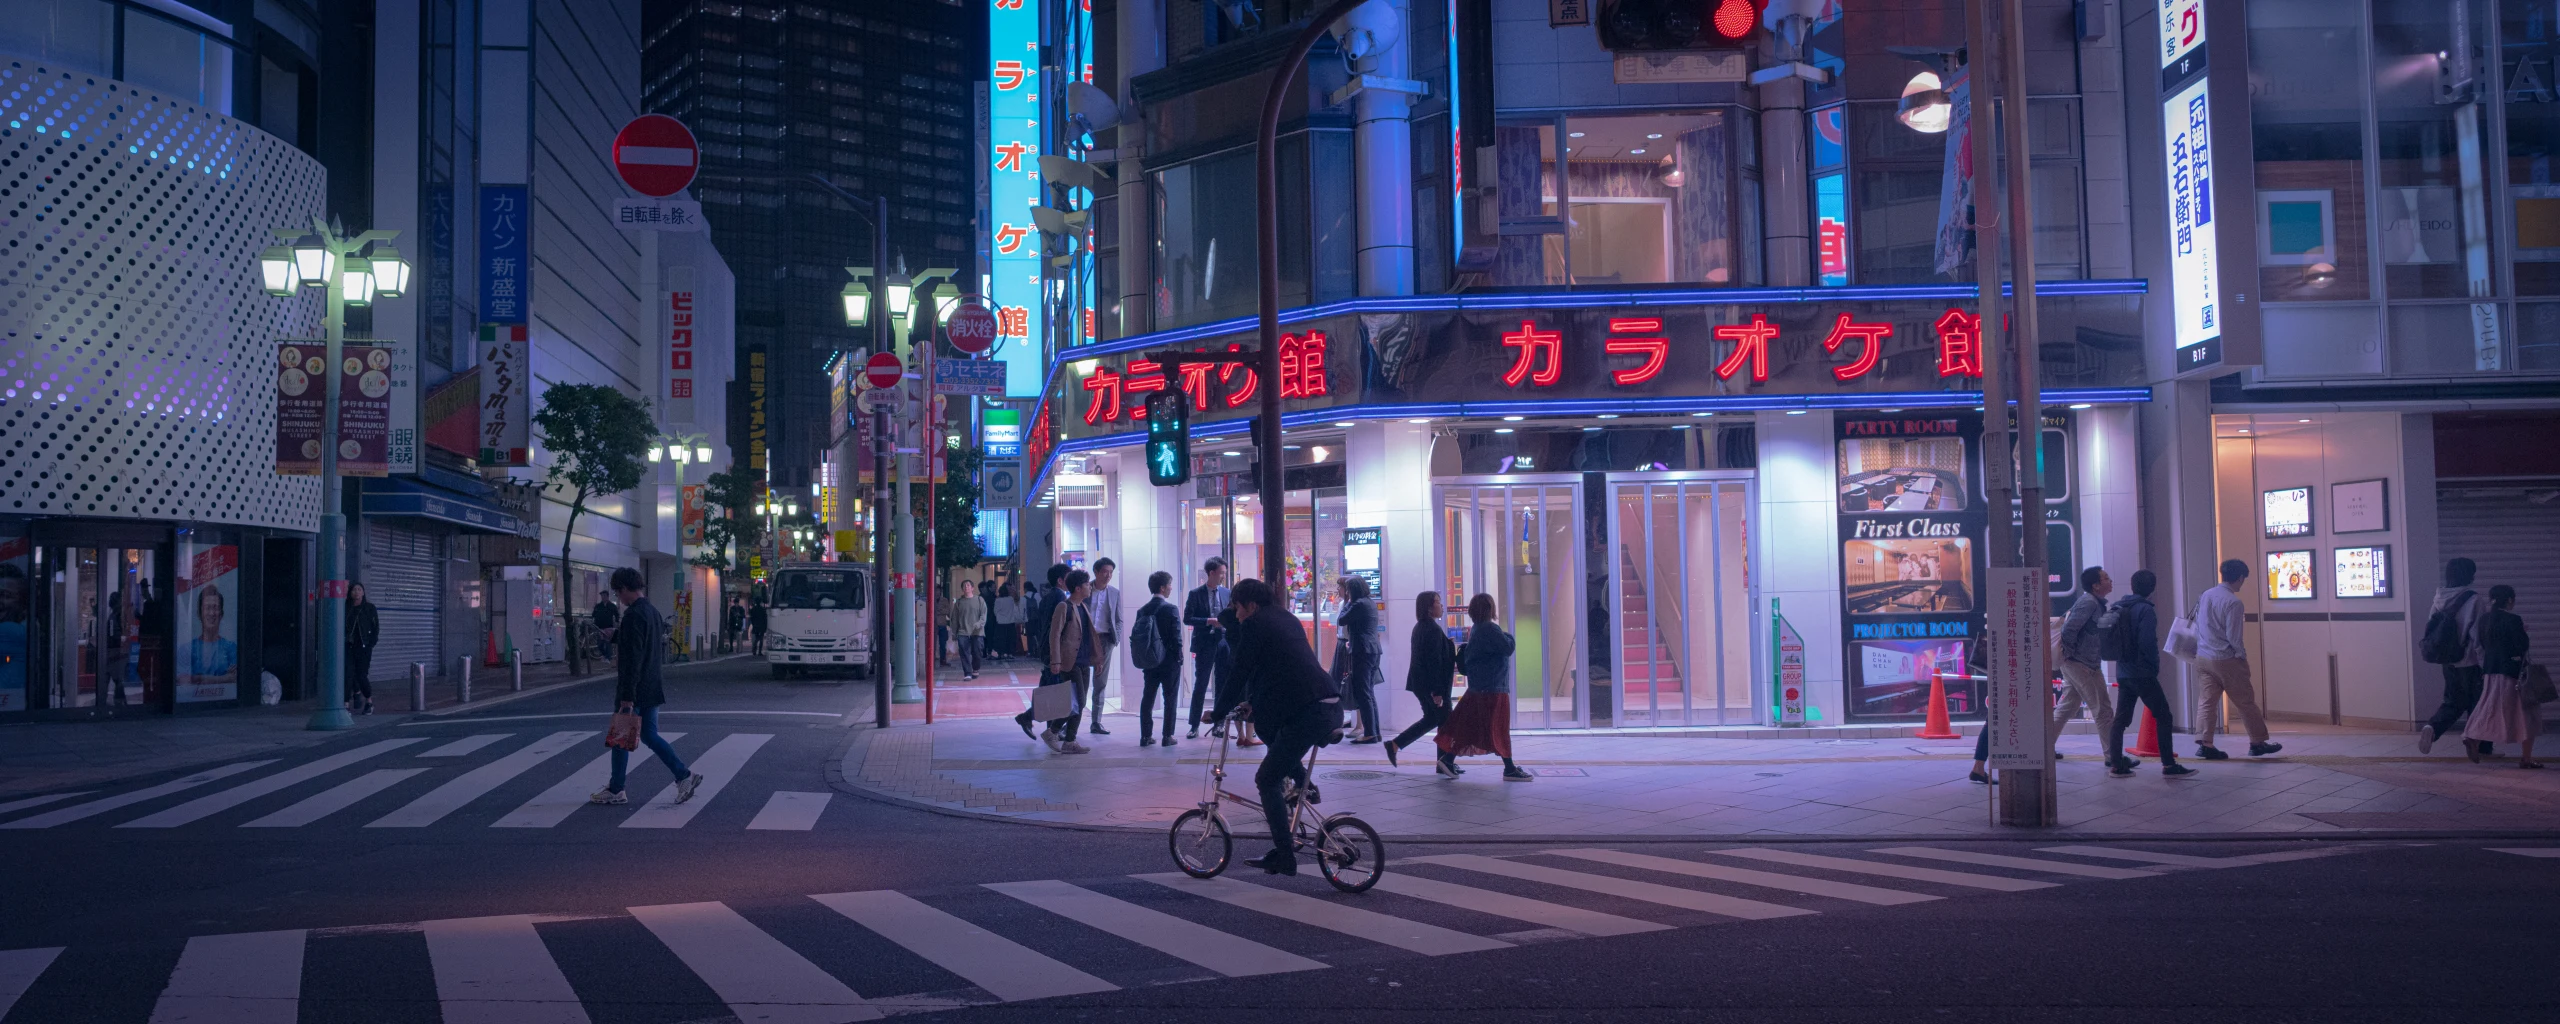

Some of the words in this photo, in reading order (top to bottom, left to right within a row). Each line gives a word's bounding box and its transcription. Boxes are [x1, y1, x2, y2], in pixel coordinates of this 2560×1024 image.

[2182, 0, 2199, 47] グ
[2181, 59, 2189, 74] 1F
[2190, 98, 2206, 150] 元祖
[2173, 131, 2193, 257] 五右衛門
[493, 193, 516, 250] カバン
[621, 206, 693, 225] 自転車を除く
[492, 257, 516, 317] 新盛堂
[672, 291, 692, 370] ビックロ
[952, 319, 993, 338] 消火栓
[2193, 348, 2206, 362] B1F
[955, 362, 1006, 379] セキネ
[282, 420, 320, 428] SHINJUKU
[343, 421, 385, 429] SHINJUKU
[1845, 420, 1899, 434] PARTY
[1903, 419, 1958, 434] ROOM
[985, 430, 1019, 439] FamilyMart
[496, 451, 509, 461] B1
[1000, 446, 1018, 455] たばこ
[1854, 519, 1904, 538] First
[1907, 518, 1961, 537] Class
[1853, 622, 1927, 639] PROJECTOR
[1930, 621, 1969, 637] ROOM
[2006, 581, 2019, 751] 一般車は路外駐車場をご利用ください。
[1783, 672, 1802, 680] GROUP
